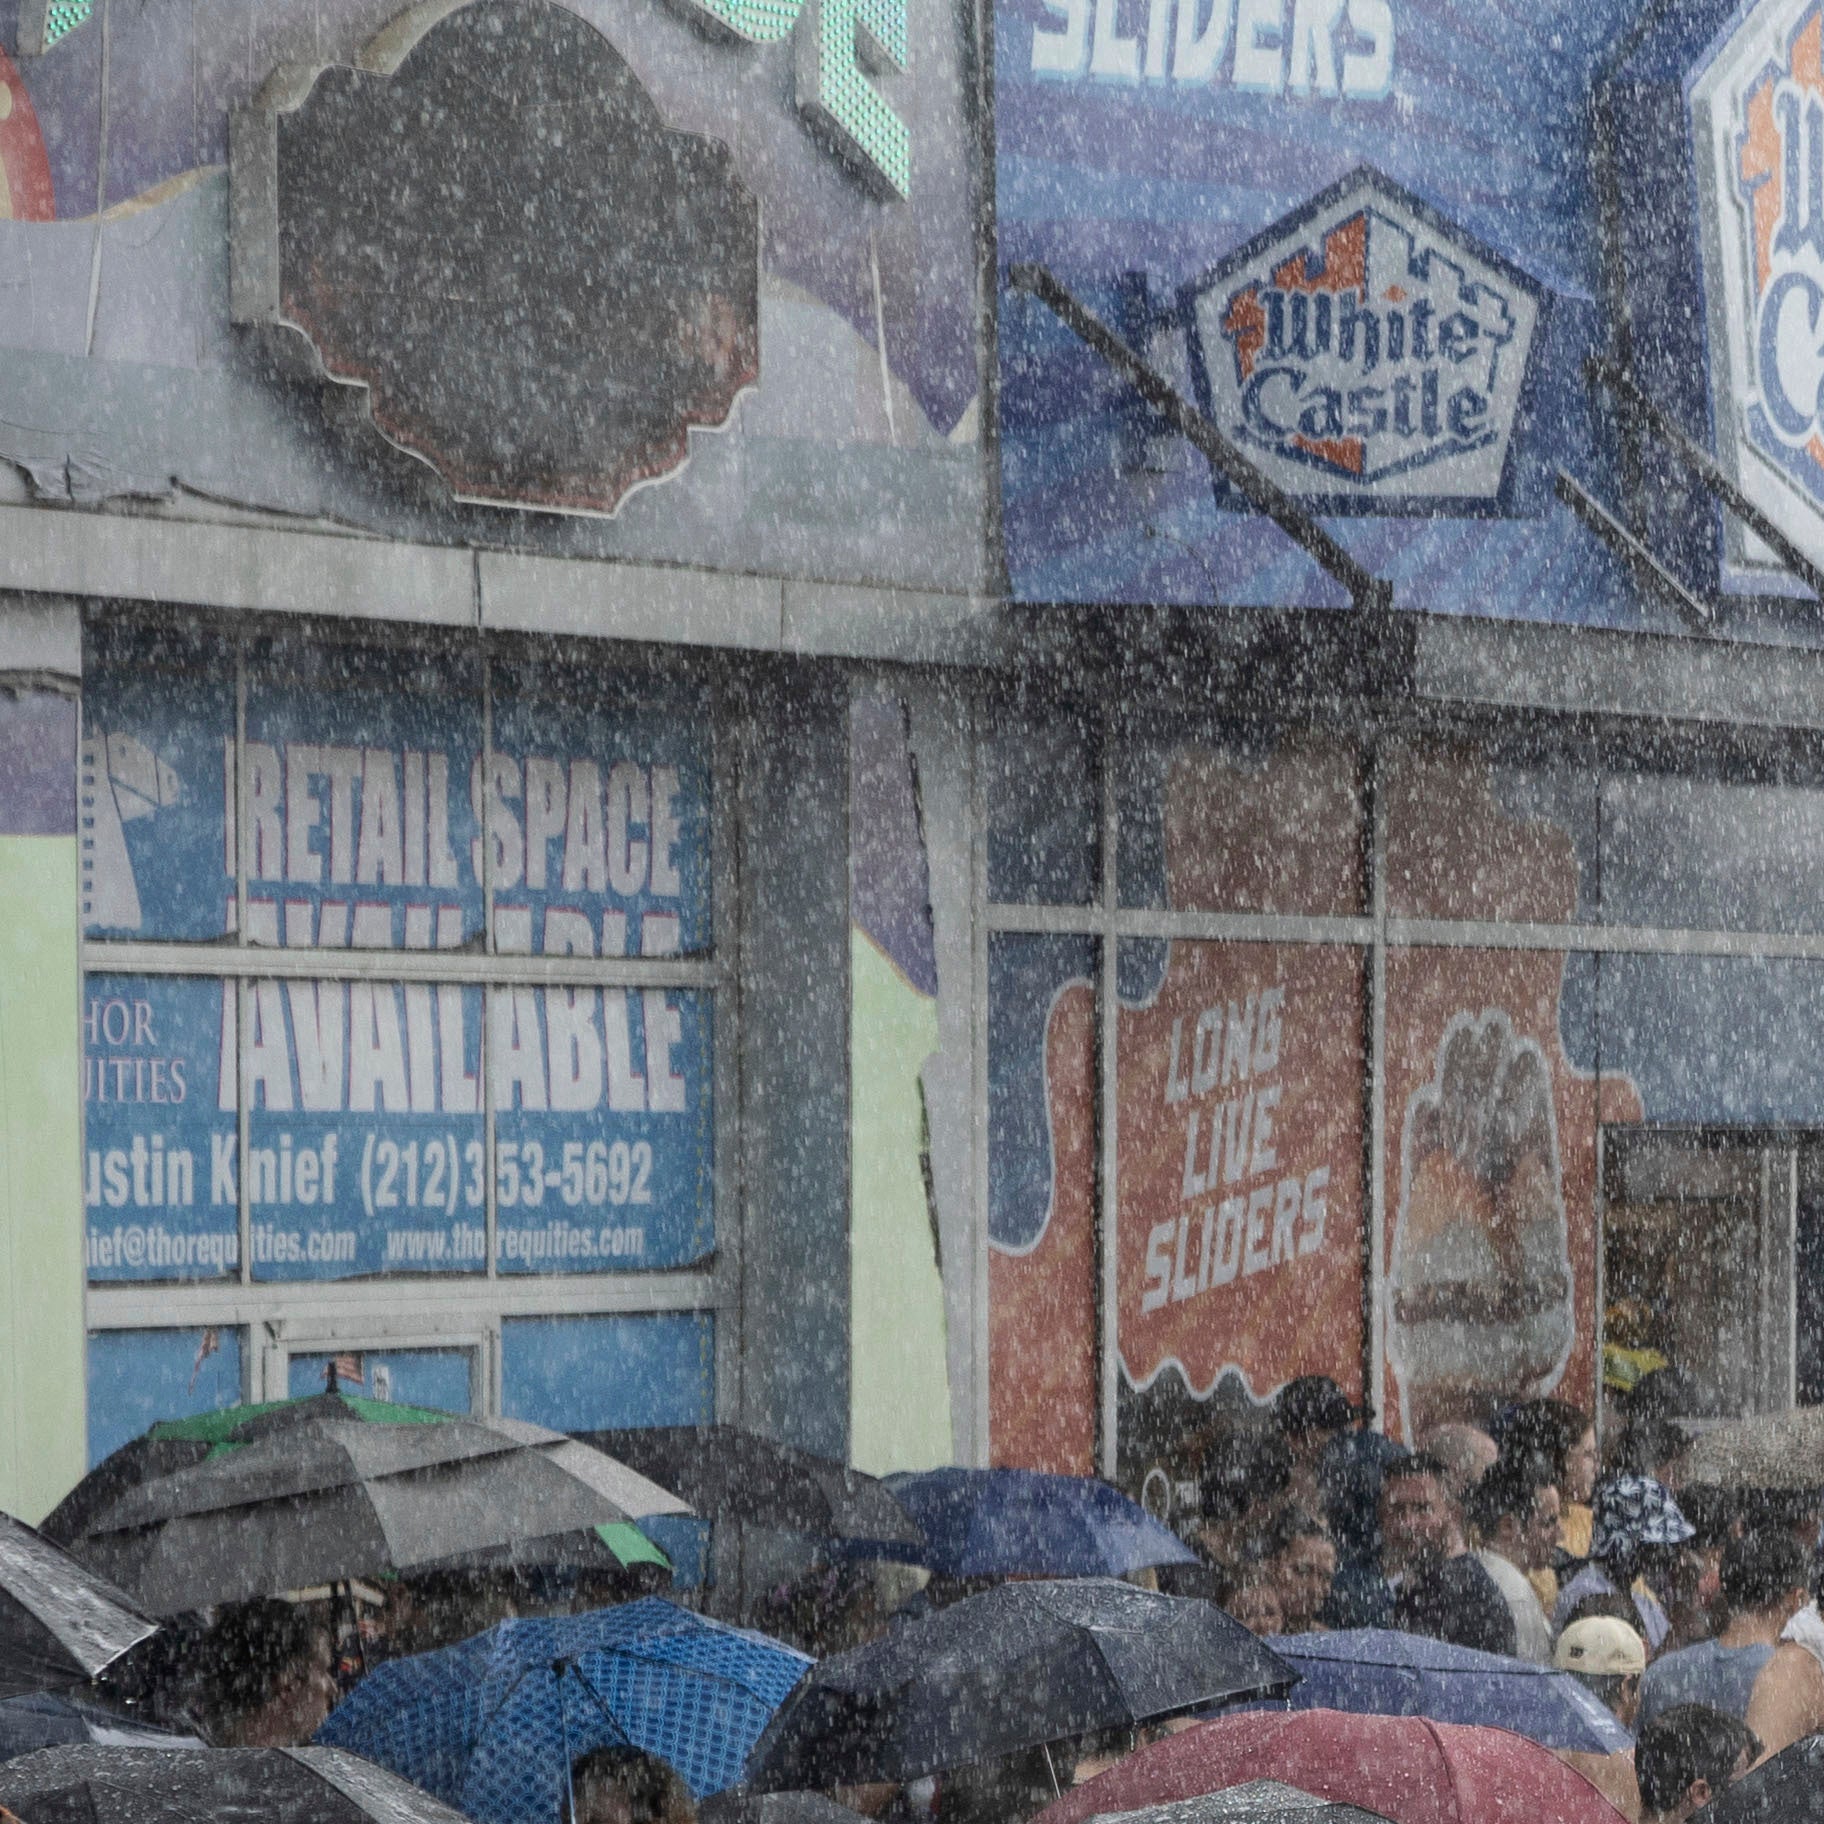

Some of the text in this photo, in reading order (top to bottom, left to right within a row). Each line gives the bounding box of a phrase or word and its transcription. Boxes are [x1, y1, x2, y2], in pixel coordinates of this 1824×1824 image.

[1260, 288, 1481, 377] White
[1241, 366, 1489, 441] Castle
[222, 734, 682, 897] RETAIL SPACE
[84, 999, 157, 1048] HOR
[218, 897, 690, 1114] AVAILABLE
[1164, 984, 1287, 1104] LONG
[84, 1133, 195, 1207] ustin
[211, 1133, 338, 1206] Knief
[1182, 1082, 1283, 1201] LIVE
[86, 1224, 357, 1274] ief@thorequities.com
[1141, 1164, 1331, 1315] SLIDERS
